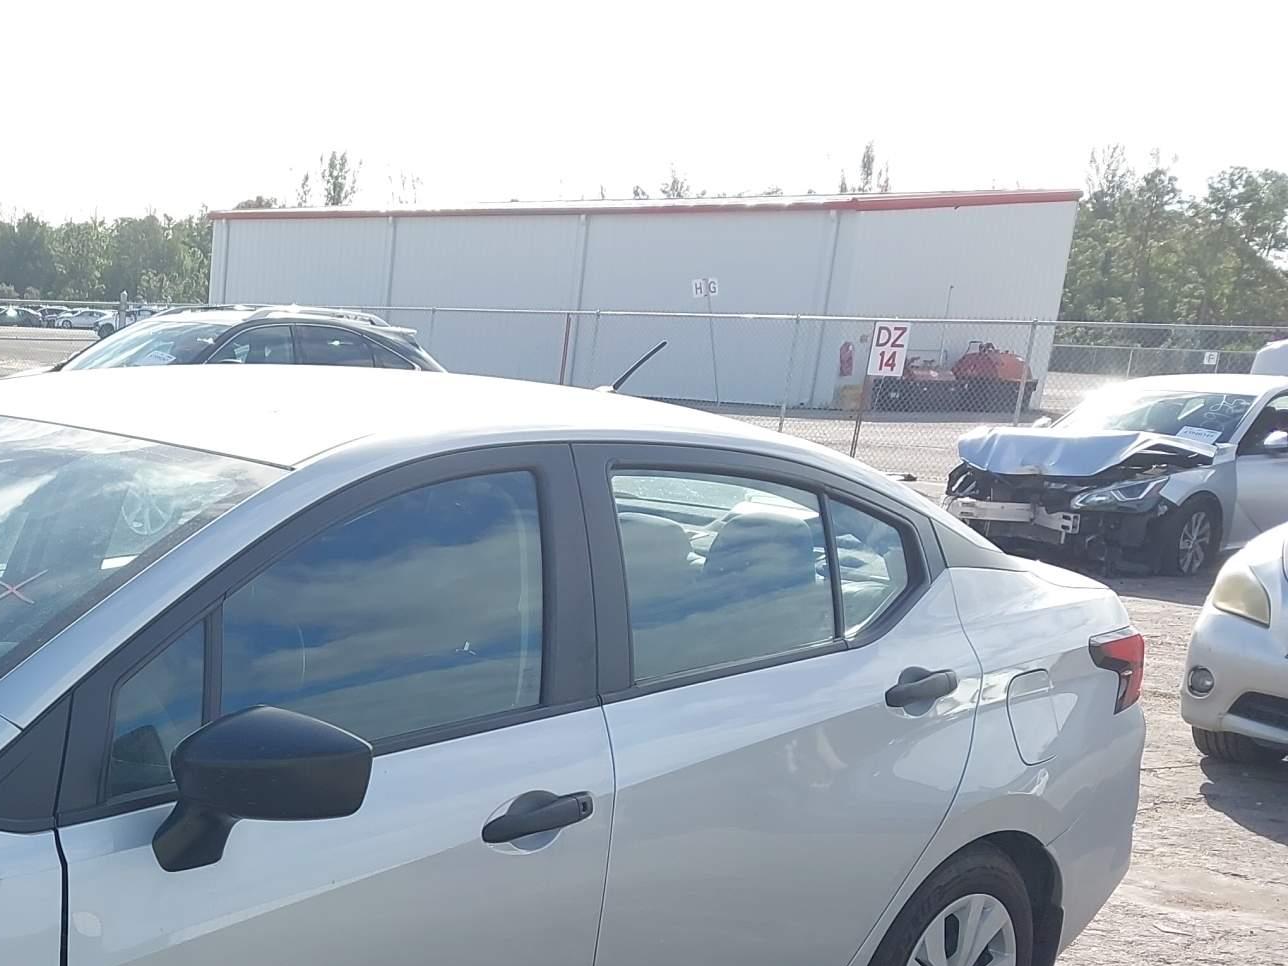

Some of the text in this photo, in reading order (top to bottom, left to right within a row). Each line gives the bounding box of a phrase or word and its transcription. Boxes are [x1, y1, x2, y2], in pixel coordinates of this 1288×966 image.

[695, 280, 717, 295] H G
[875, 326, 908, 348] DZ
[879, 350, 897, 371] 14
